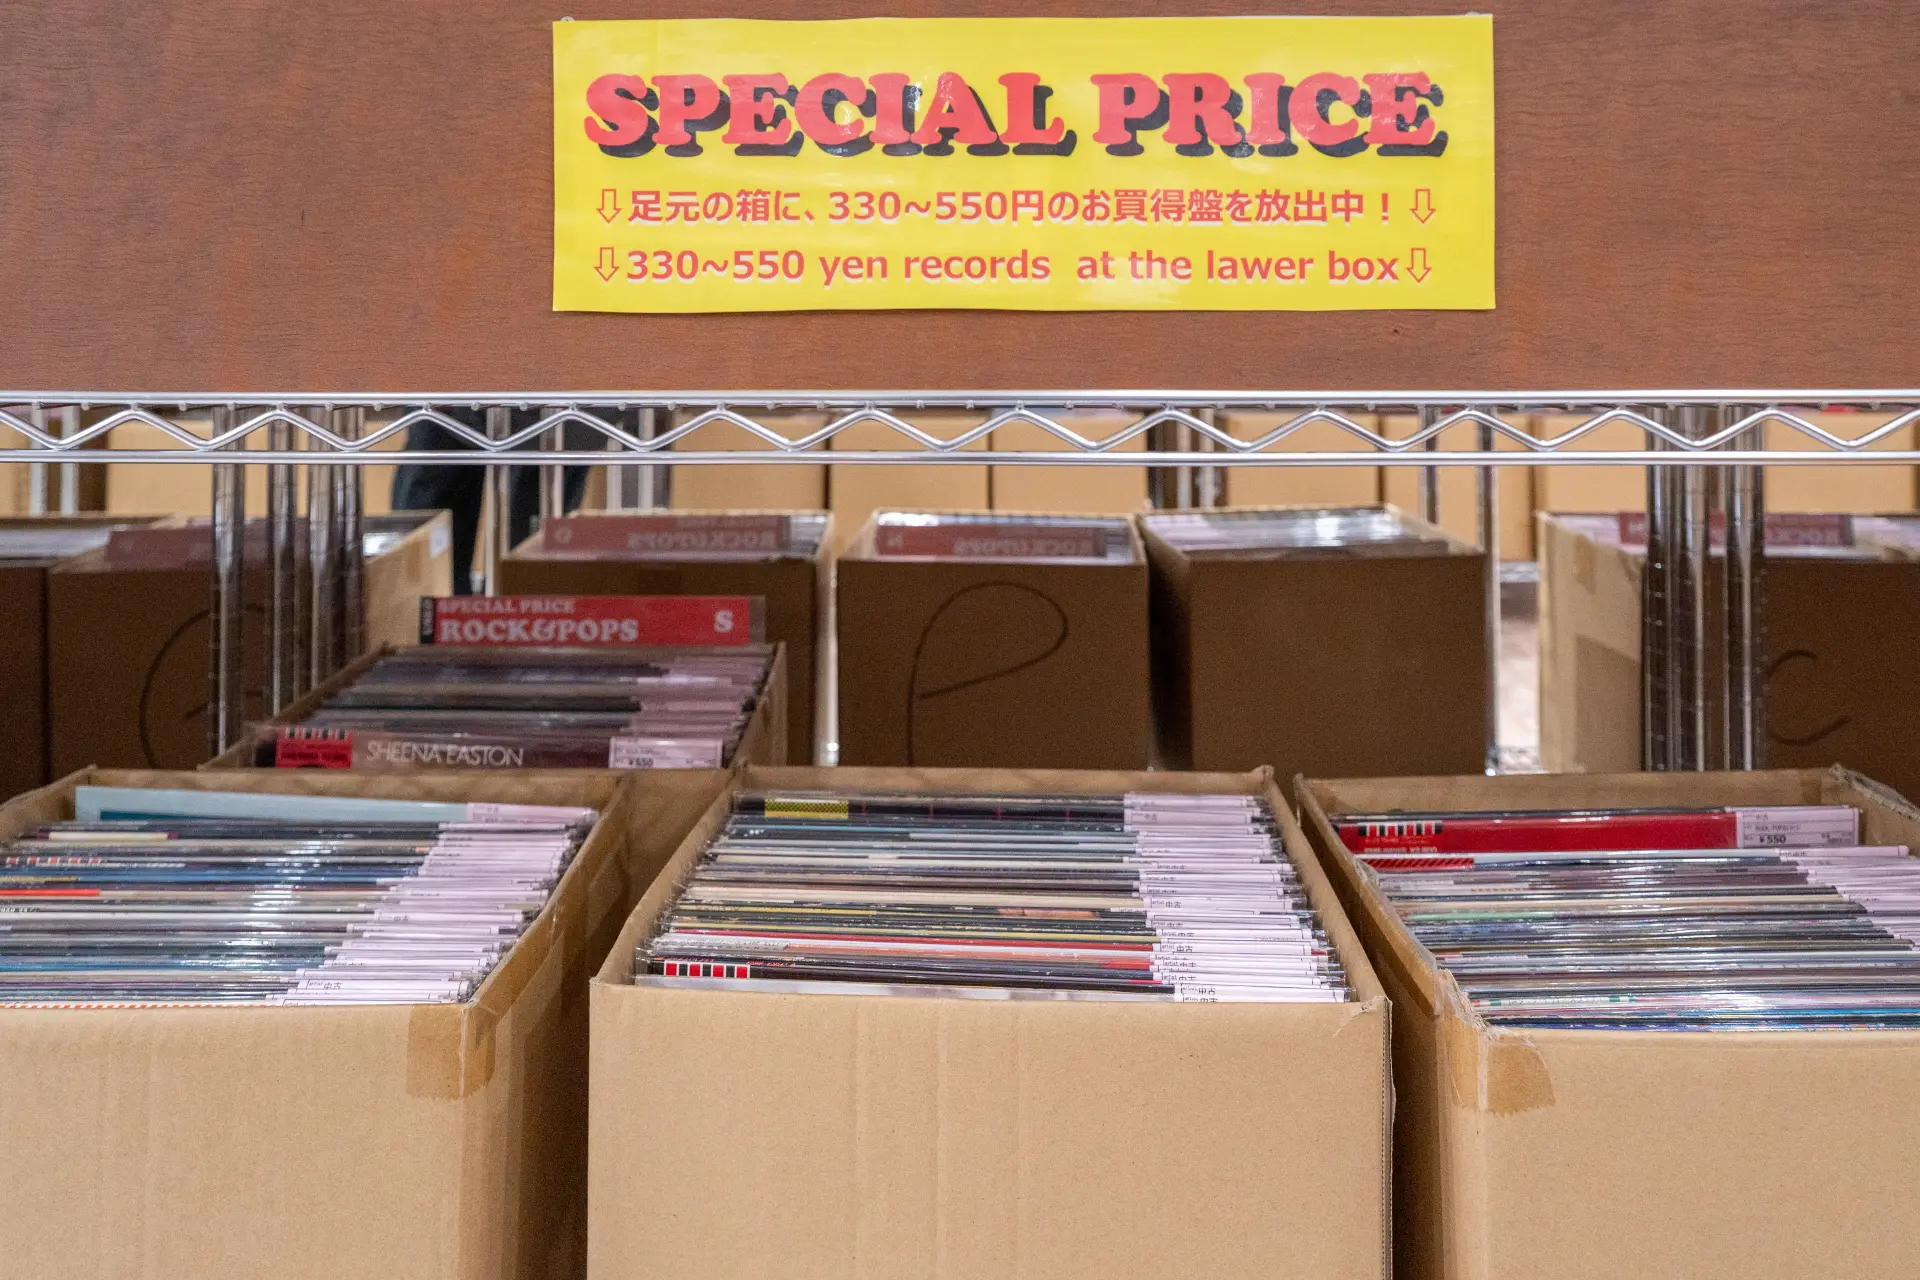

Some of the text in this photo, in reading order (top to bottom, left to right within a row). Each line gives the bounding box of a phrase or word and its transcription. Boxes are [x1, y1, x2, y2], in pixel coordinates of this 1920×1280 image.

[584, 72, 1448, 158] SPECIAL PRICE
[626, 249, 1400, 287] 330~550 yen records at the lawer box
[438, 599, 576, 613] SPECIAL PRICE
[440, 618, 639, 643] ROCK&POPS
[713, 610, 734, 633] S
[366, 740, 442, 763] SHEENA
[446, 743, 524, 767] EASTON
[1759, 834, 1787, 844] ¥550
